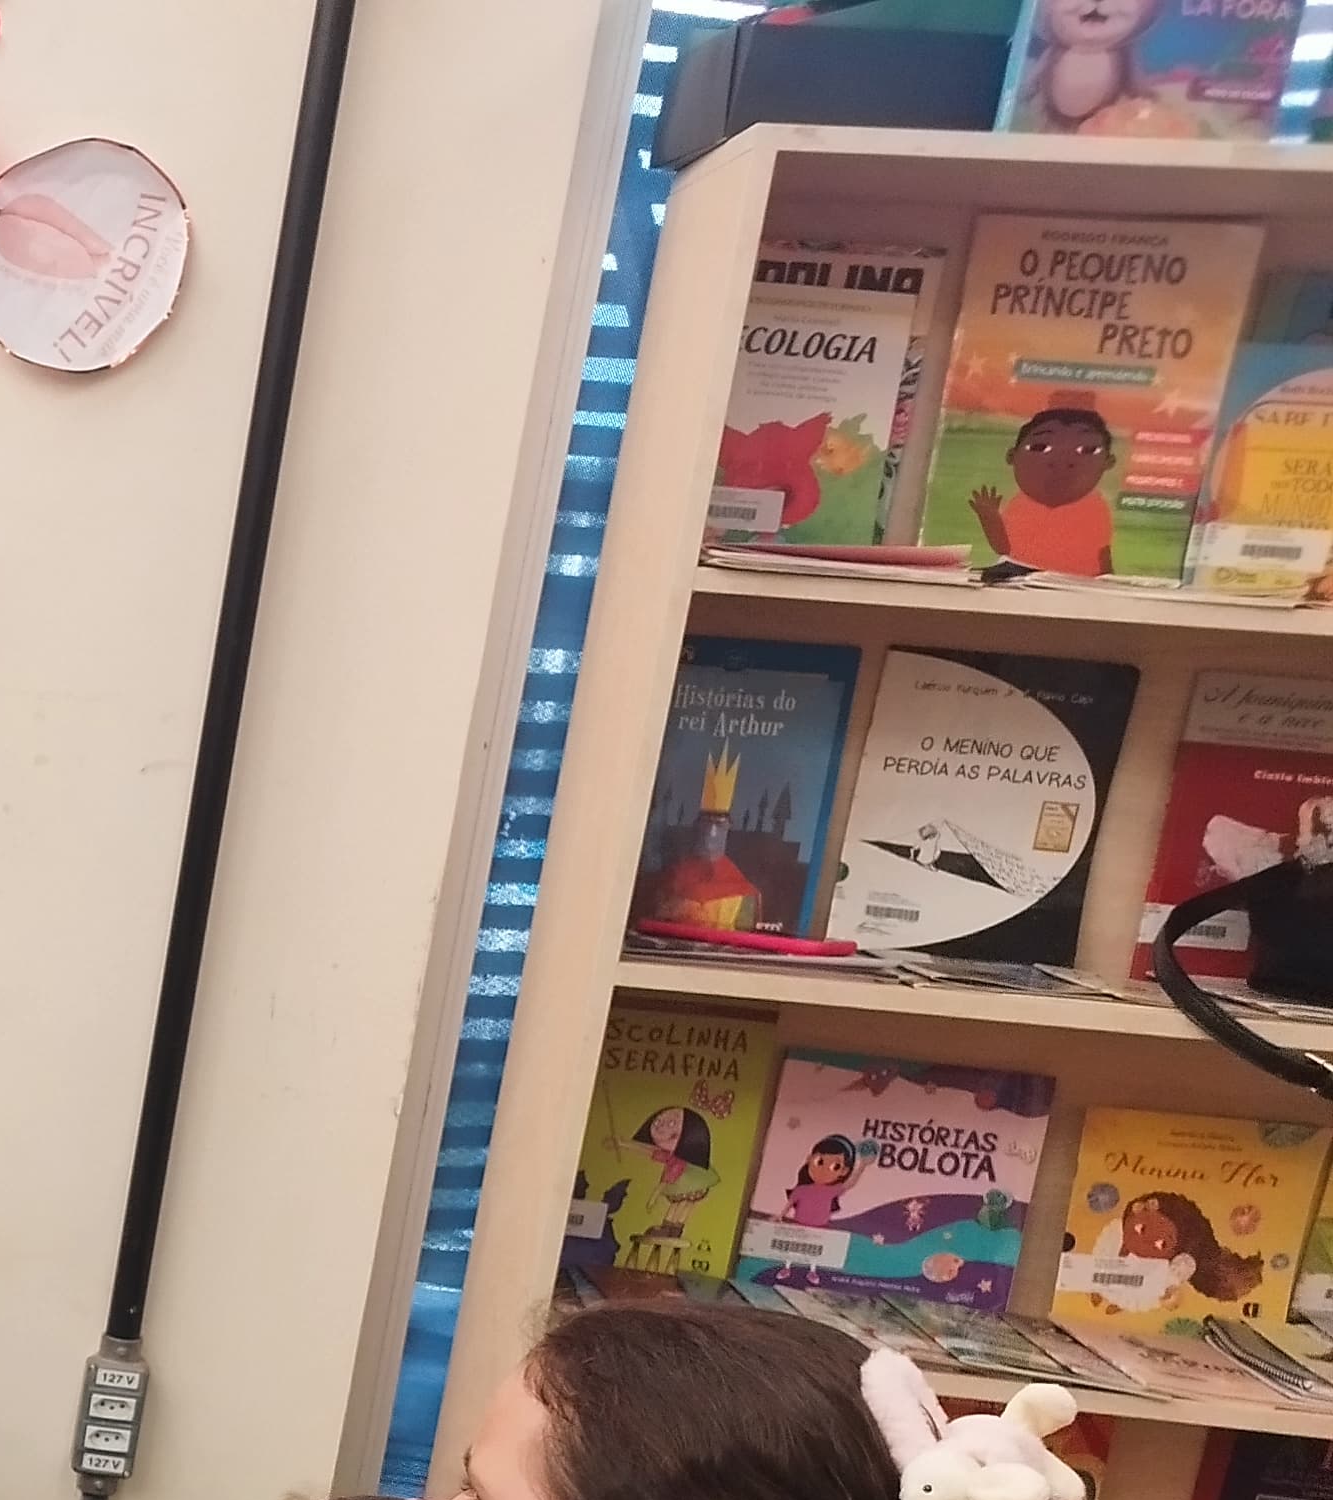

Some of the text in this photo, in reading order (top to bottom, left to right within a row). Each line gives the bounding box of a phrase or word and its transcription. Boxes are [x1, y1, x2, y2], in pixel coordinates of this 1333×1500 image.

[1020, 248, 1187, 285] O PEQUENO
[990, 277, 1133, 320] PRÍNCIPE
[741, 325, 877, 364] COLOGIA
[1097, 323, 1193, 360] PRETO
[773, 689, 797, 711] do
[678, 711, 784, 737] rei Arthur
[921, 736, 934, 751] O
[1020, 745, 1061, 762] QUE
[955, 764, 981, 780] AS
[987, 765, 1087, 790] PALAVRAS
[606, 1018, 748, 1054] SCOLINHA
[604, 1047, 739, 1081] SERAFINA
[862, 1117, 998, 1152] HISTÓRIAS
[877, 1143, 997, 1183] BOLOTA
[102, 1372, 135, 1386] 127 V
[88, 1456, 121, 1471] 127 V
